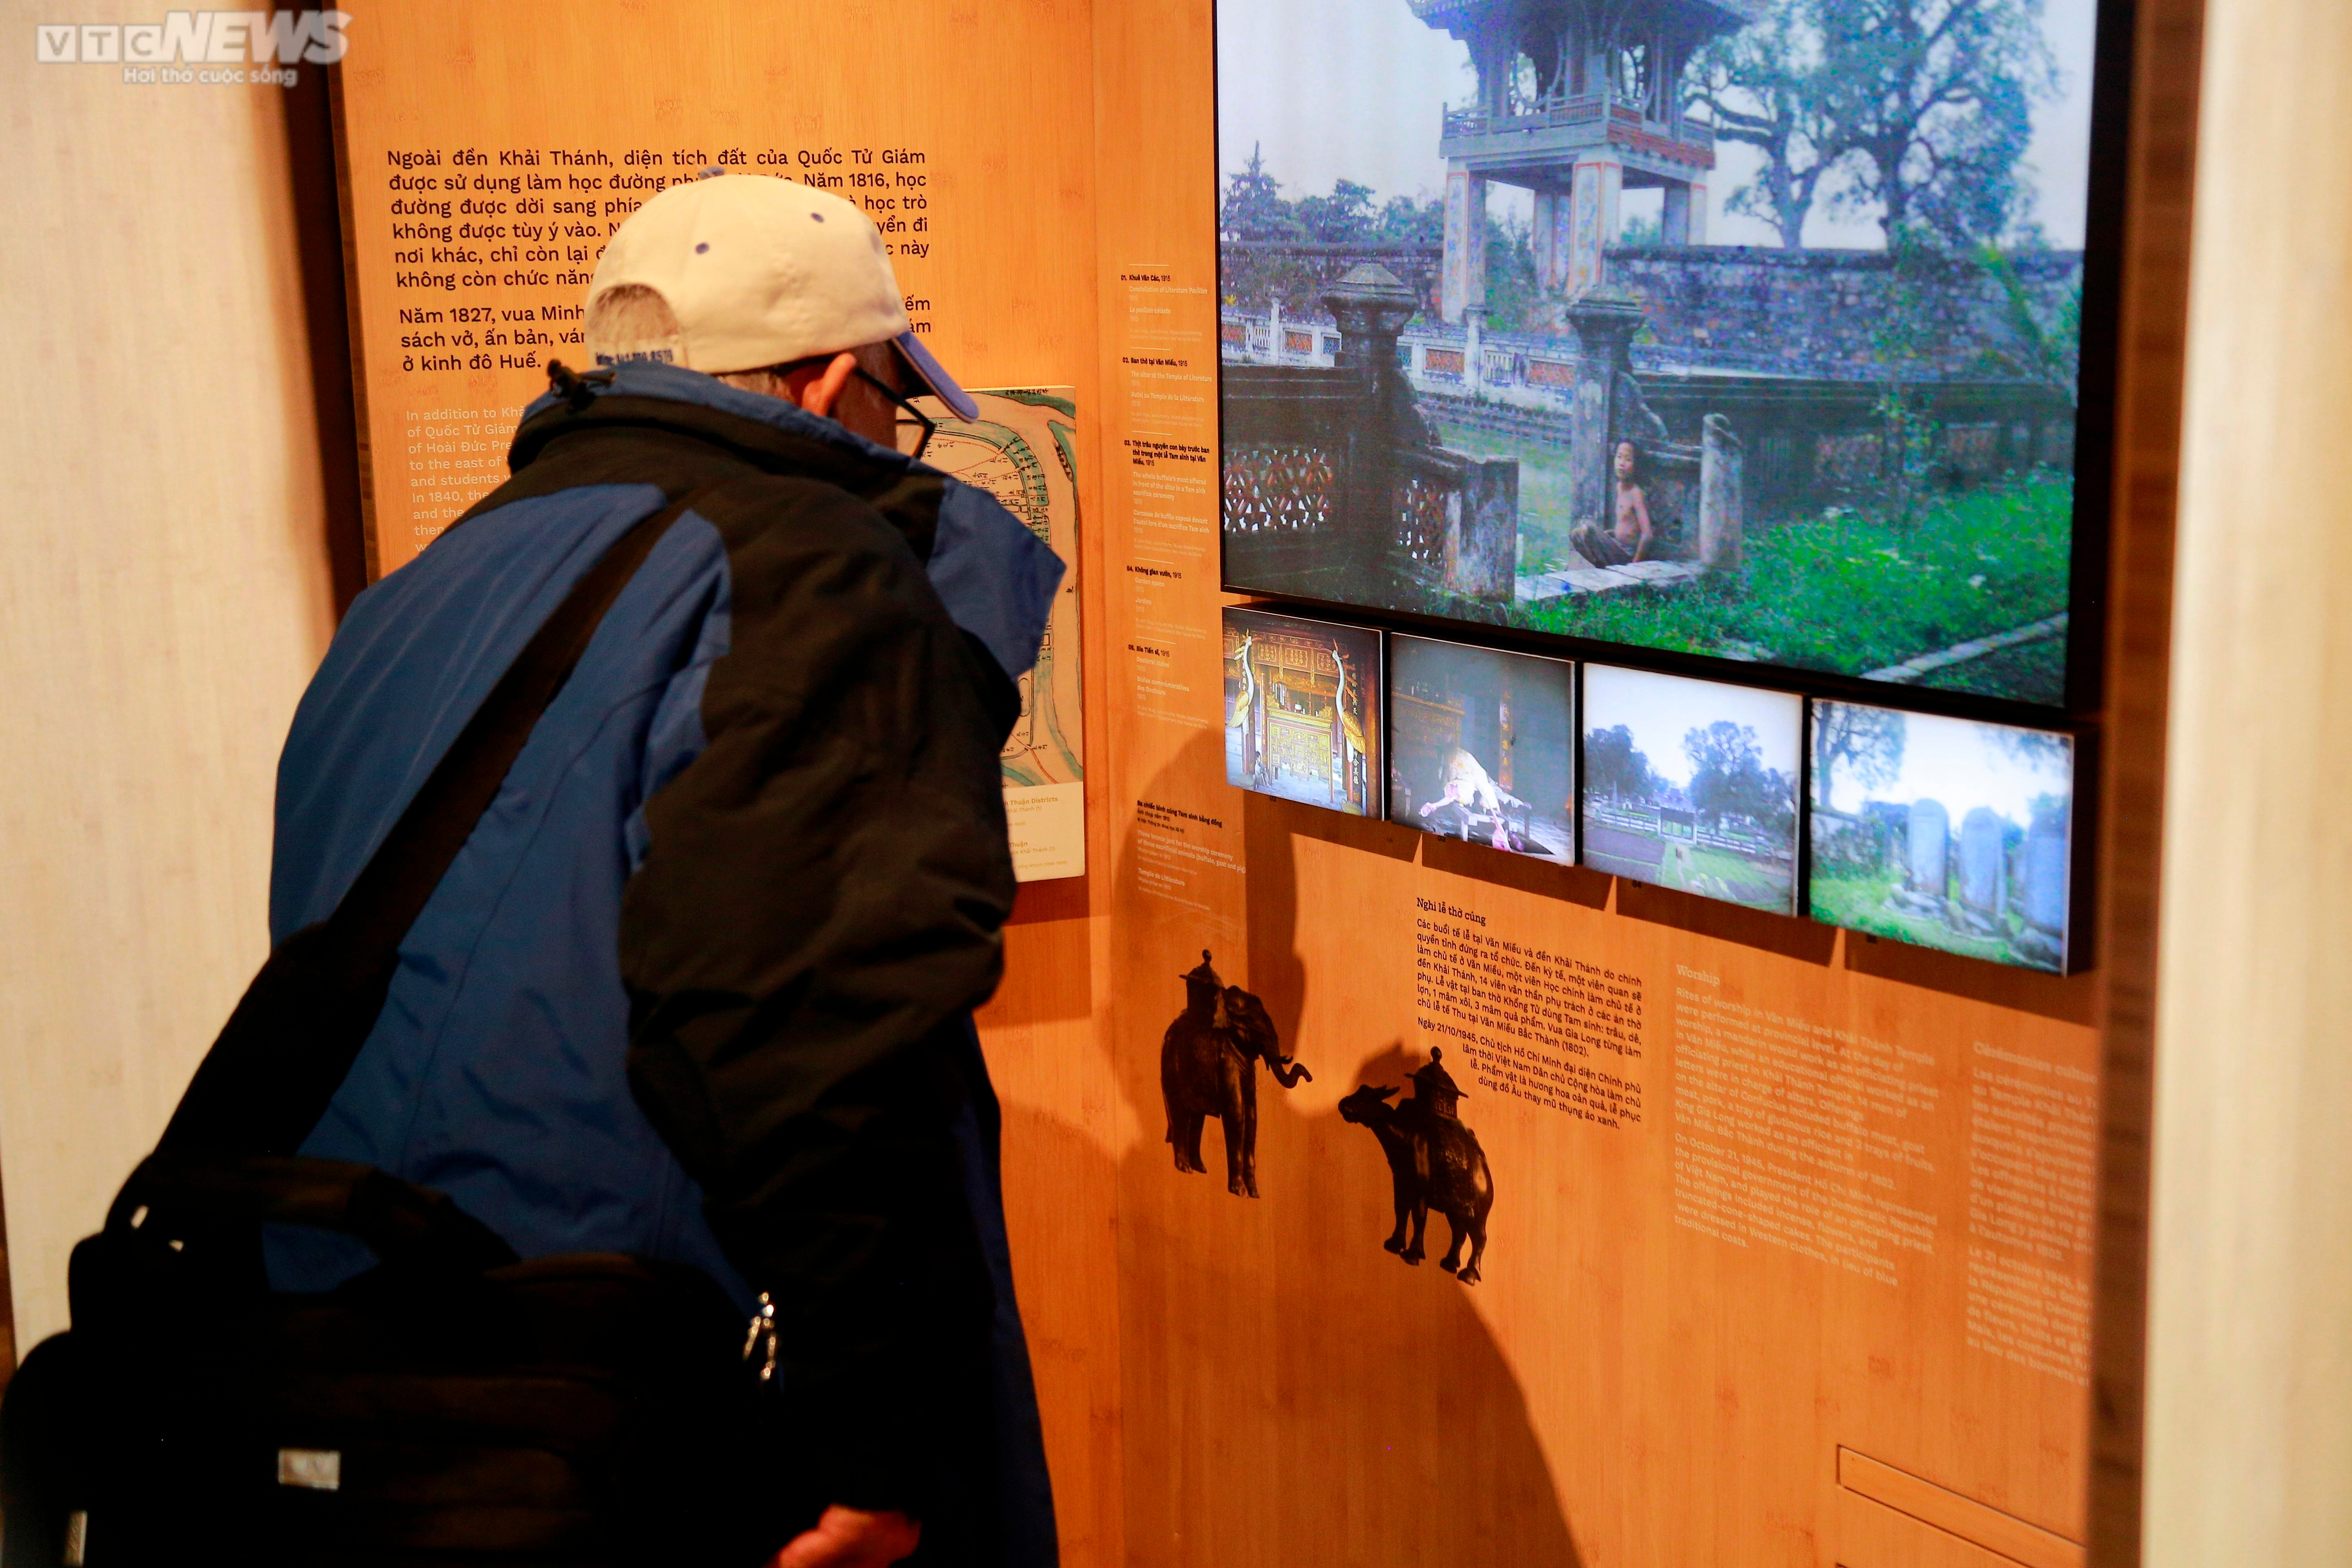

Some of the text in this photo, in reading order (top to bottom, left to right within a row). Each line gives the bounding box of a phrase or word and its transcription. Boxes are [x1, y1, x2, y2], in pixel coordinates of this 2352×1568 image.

[388, 147, 924, 169] Ngoài đền Khải Thánh, diện tích đất của Quốc Tử Giám
[390, 174, 437, 194] được
[445, 174, 467, 190] sử
[474, 174, 521, 194] dụng
[528, 174, 561, 189] làm
[569, 174, 602, 194] học
[610, 173, 665, 192] đường
[804, 172, 842, 187] Năm
[849, 173, 889, 189] 1816,
[896, 172, 926, 190] học
[391, 198, 451, 218] đường
[461, 198, 506, 218] được
[516, 198, 543, 214] dời
[554, 200, 596, 217] sang
[865, 195, 895, 214] học
[903, 194, 927, 209] trò
[393, 223, 452, 243] không
[459, 223, 506, 242] được
[512, 222, 542, 242] tùy
[549, 221, 558, 241] ý
[564, 221, 601, 237] vào.
[913, 217, 927, 232] đi
[395, 239, 929, 265] nơi khác, chỉ còn lại này
[397, 269, 594, 291] không còn chức năn
[400, 308, 443, 323] Năm
[450, 307, 495, 324] 1827,
[501, 310, 535, 321] vua
[542, 304, 584, 320] Minh
[401, 331, 445, 347] sách
[451, 330, 478, 348] vở,
[486, 328, 507, 345] ấn
[514, 328, 553, 346] bản,
[403, 351, 541, 372] ở kinh đô Huế.
[407, 411, 418, 420] In
[424, 409, 478, 420] addition
[483, 409, 496, 418] to
[408, 426, 421, 437] of
[426, 425, 459, 439] Quốc
[464, 424, 480, 435] Tử
[409, 441, 486, 454] of Hoài Đức
[410, 456, 501, 470] to the east of
[412, 474, 499, 487] and students
[413, 493, 424, 503] In
[429, 491, 463, 502] 1840,
[414, 508, 437, 519] and
[1417, 897, 1486, 927] Nghi lễ thờ cúng
[1417, 918, 1641, 987] Các buổi tế lễ tại Văn Miếu và đền Khải Thánh do chính
[1677, 964, 1720, 987] Worship
